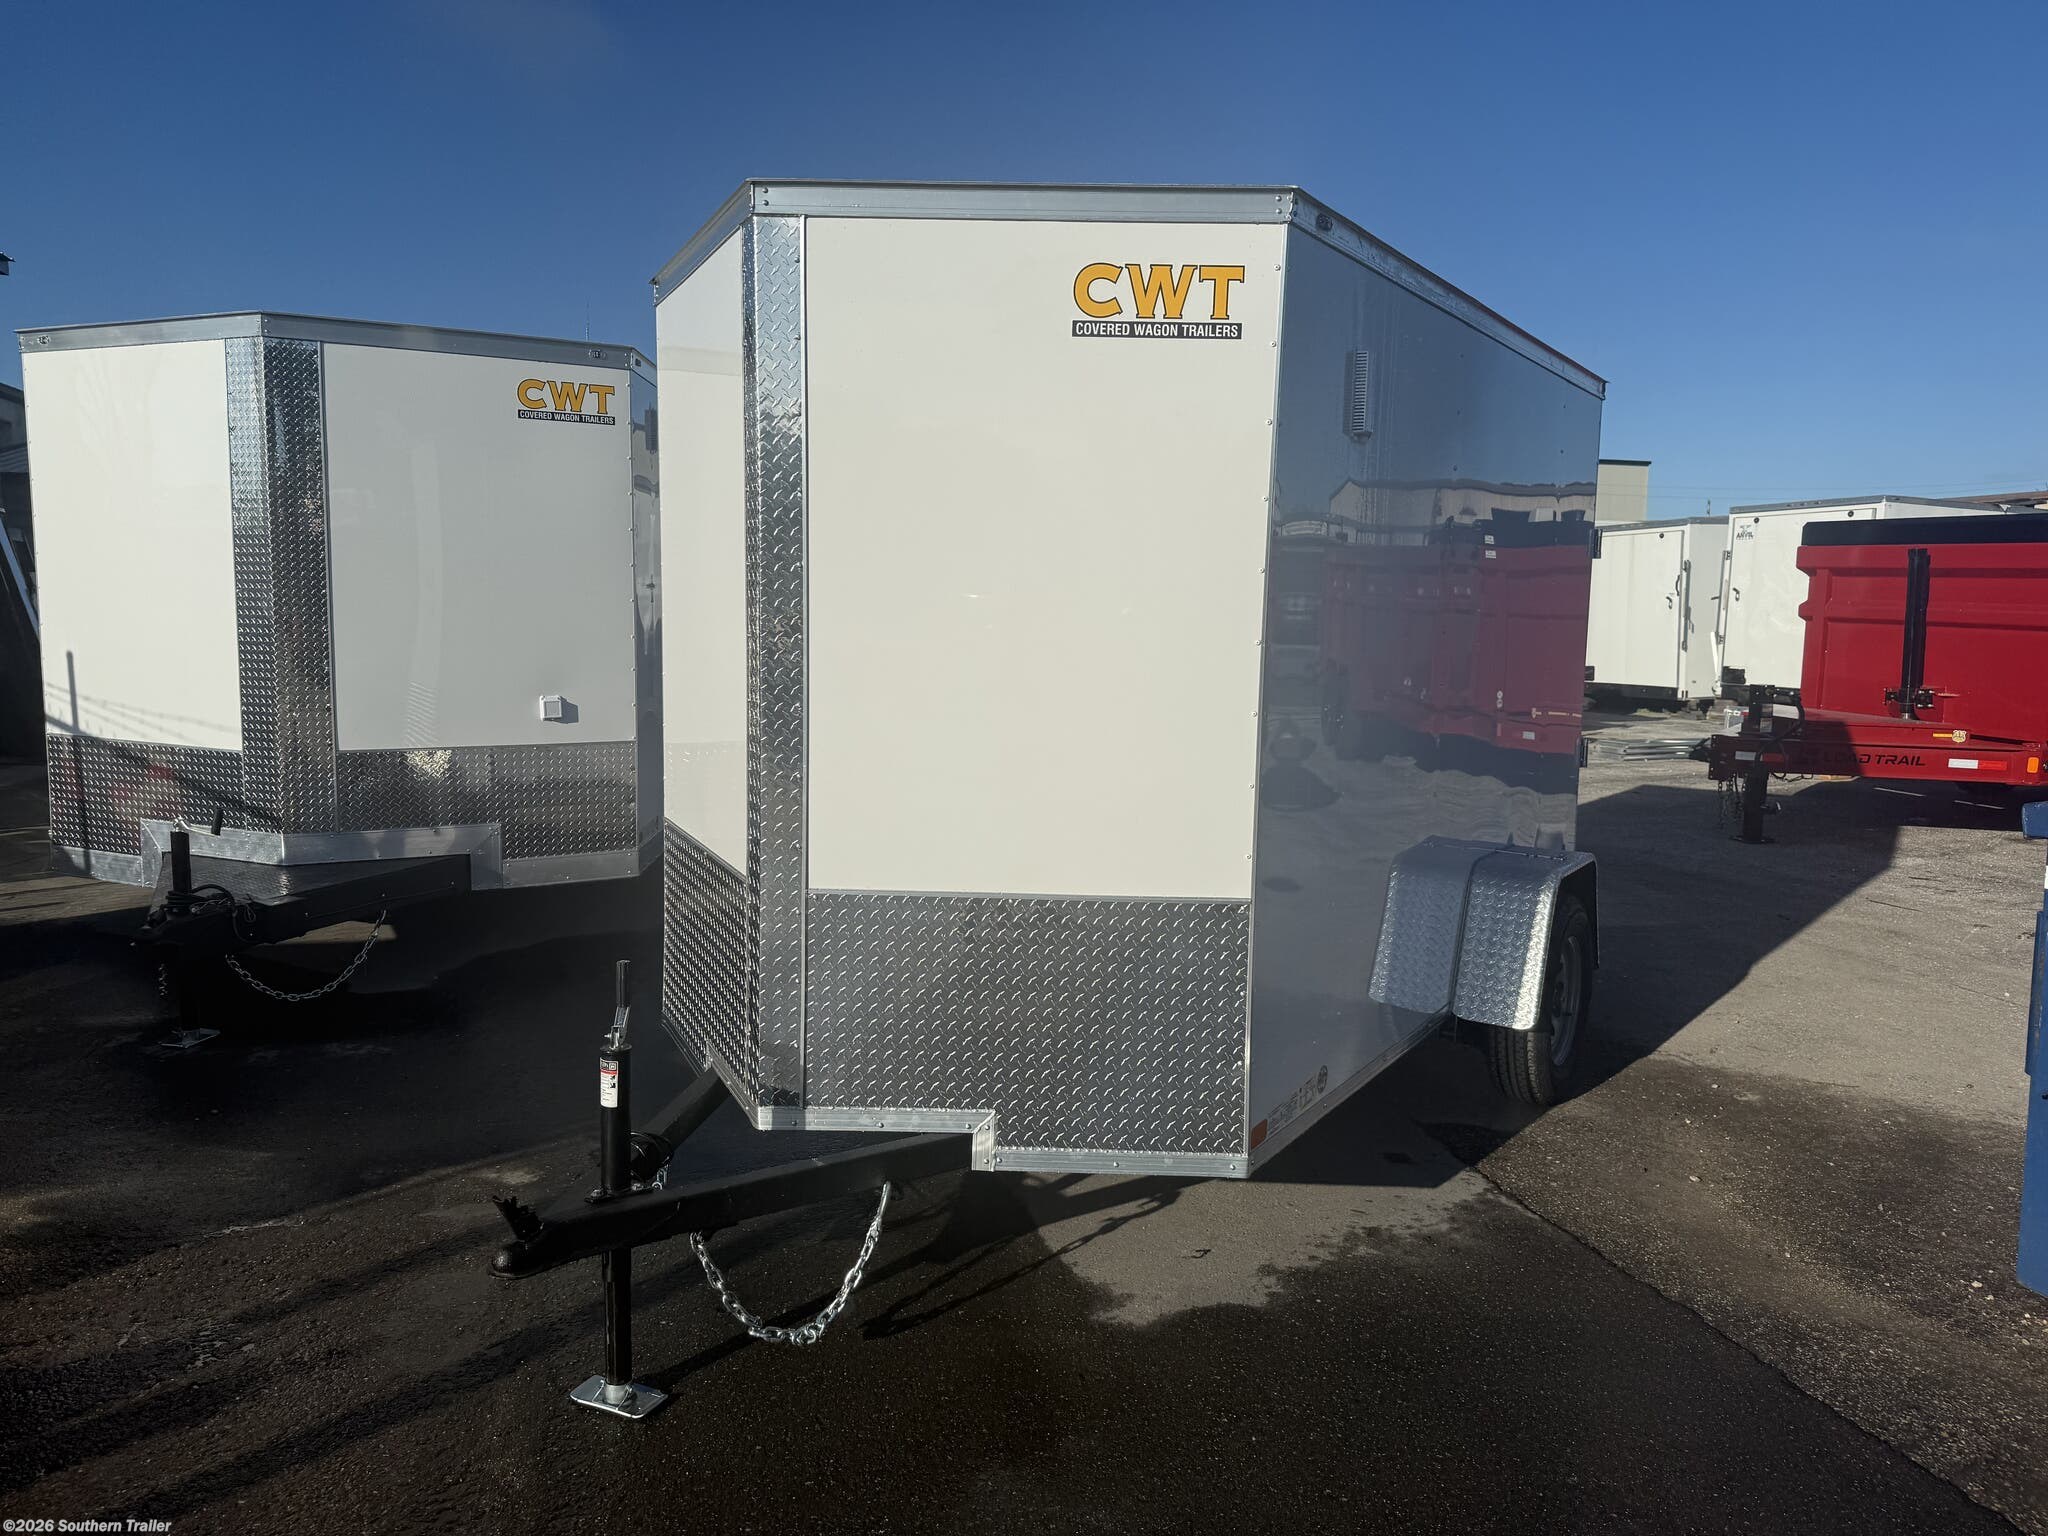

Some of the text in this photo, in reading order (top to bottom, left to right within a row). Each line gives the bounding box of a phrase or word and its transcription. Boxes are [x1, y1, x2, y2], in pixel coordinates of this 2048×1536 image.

[1073, 262, 1245, 320] CWT
[1075, 322, 1239, 338] COVERED WAGON TRAILERS
[517, 378, 615, 415] CWT
[519, 410, 614, 425] COVERED WAGON TRAILERS
[1875, 754, 1926, 767] TRAIL
